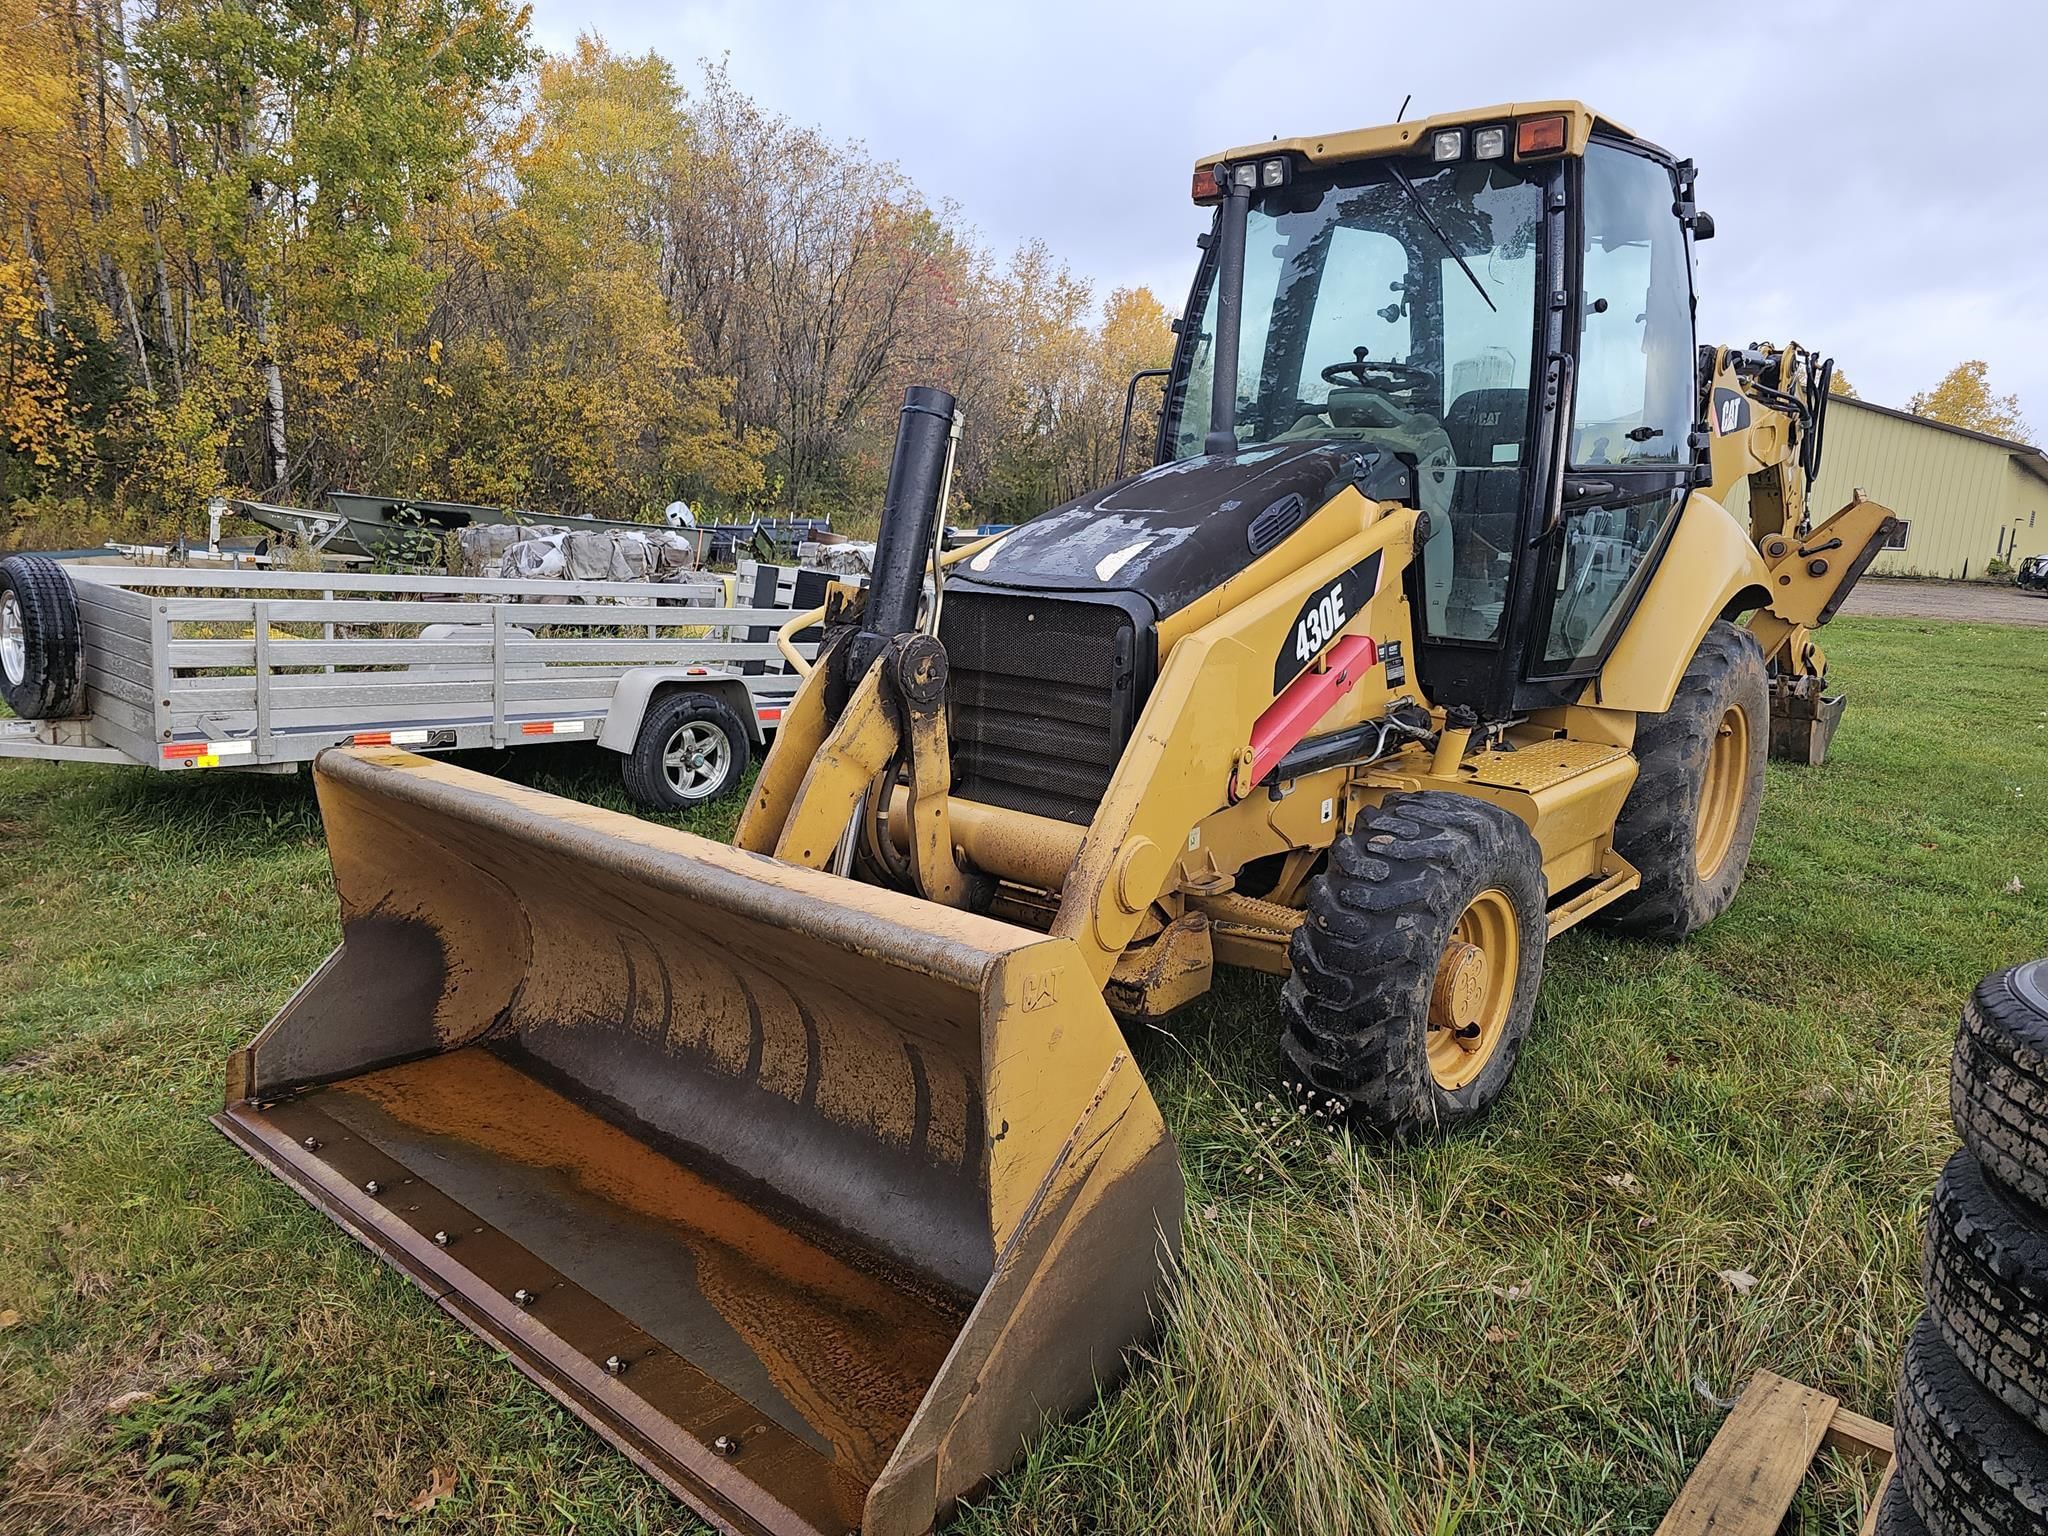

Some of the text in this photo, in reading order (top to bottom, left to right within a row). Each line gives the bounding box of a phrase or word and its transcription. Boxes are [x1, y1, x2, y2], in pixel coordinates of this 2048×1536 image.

[1479, 411, 1501, 426] CAT
[1721, 397, 1741, 433] CAT
[1296, 582, 1346, 661] 430E
[1022, 966, 1065, 1013] CAT
